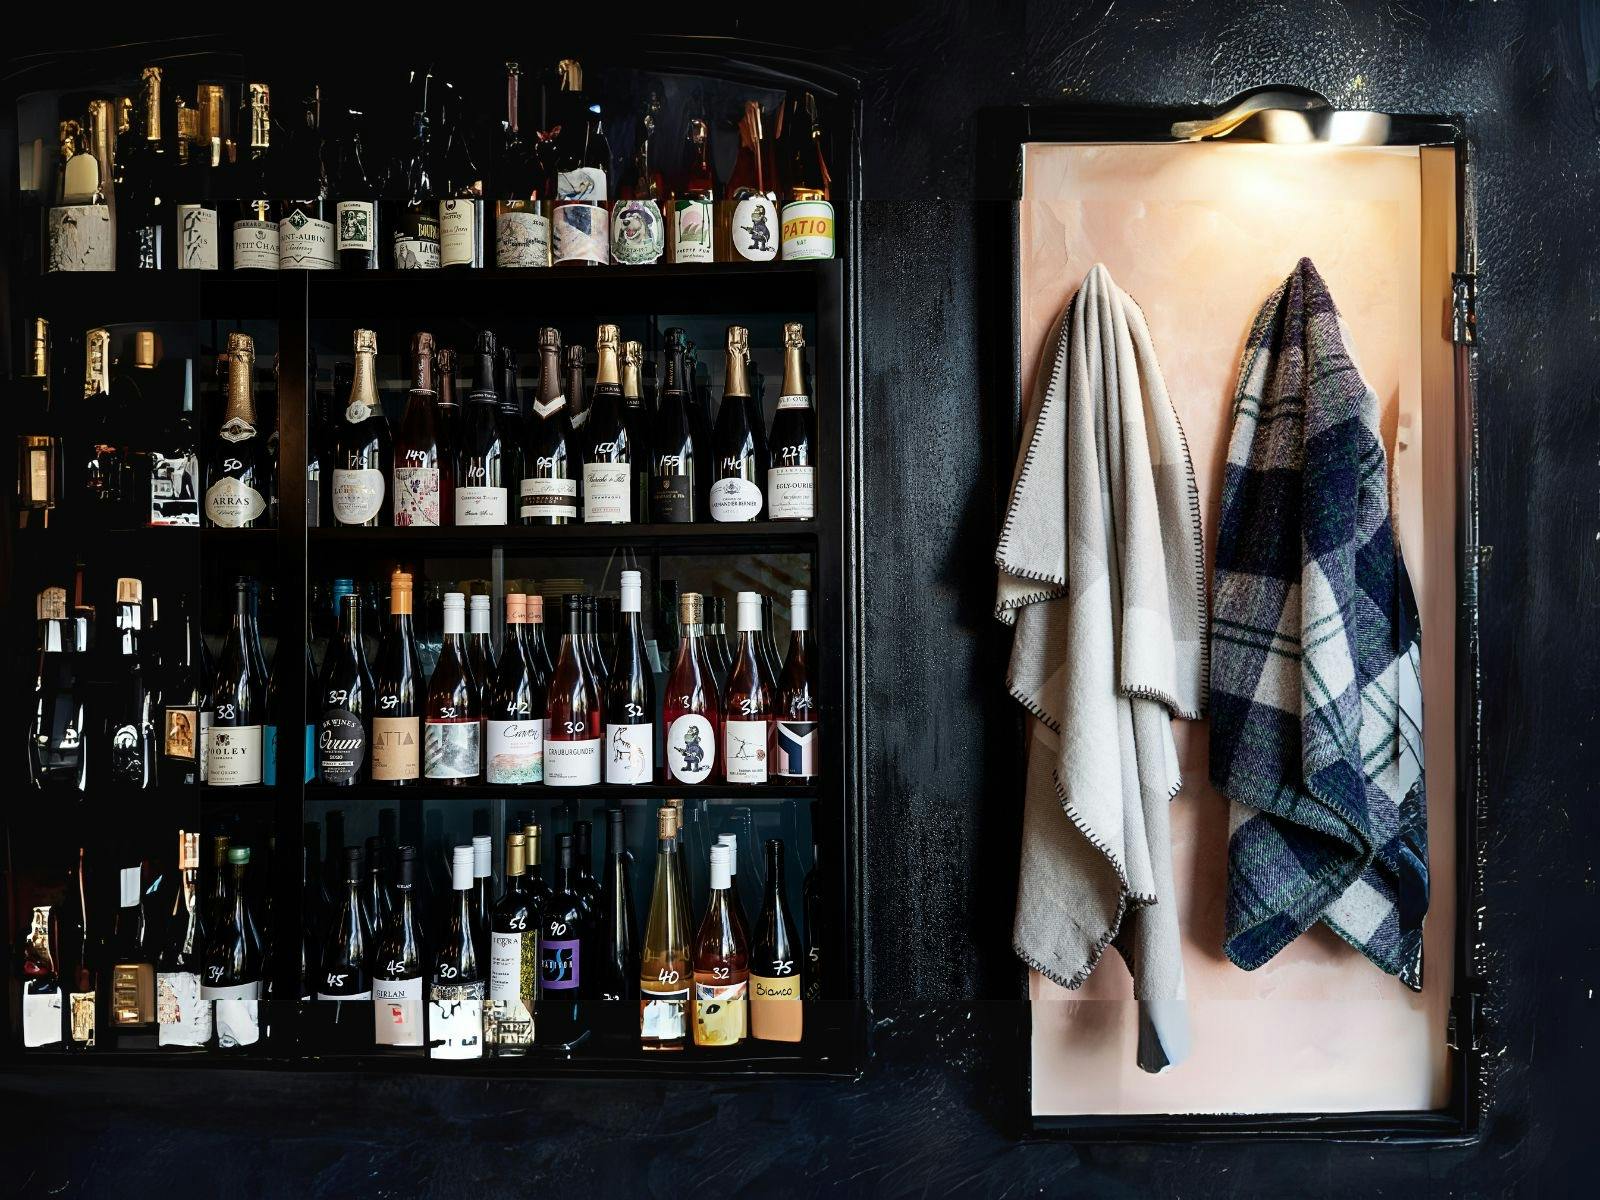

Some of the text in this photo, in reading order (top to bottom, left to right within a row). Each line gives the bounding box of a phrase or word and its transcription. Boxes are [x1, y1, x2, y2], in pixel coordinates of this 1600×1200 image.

[783, 220, 827, 239] PATIO
[405, 449, 428, 461] 140
[594, 442, 615, 455] 150
[223, 458, 243, 473] 50
[537, 456, 554, 470] 95
[660, 455, 681, 467] 155
[468, 464, 485, 478] 110
[213, 497, 250, 506] ARRAS
[329, 690, 348, 705] 37
[380, 696, 400, 709] 37
[216, 704, 235, 719] 38
[440, 707, 458, 719] 32
[507, 701, 531, 716] 42
[625, 703, 643, 717] 32
[332, 719, 357, 728] WINES
[563, 721, 585, 734] 30
[319, 729, 362, 750] Ovum
[508, 915, 526, 930] 56
[550, 921, 567, 936] 90
[809, 947, 820, 962] 5
[208, 966, 225, 983] 34
[387, 960, 405, 975] 45
[440, 963, 458, 979] 30
[712, 967, 730, 980] 32
[772, 961, 794, 976] 75
[327, 973, 349, 988] 45
[658, 968, 679, 985] 40
[756, 983, 793, 996] Bianco
